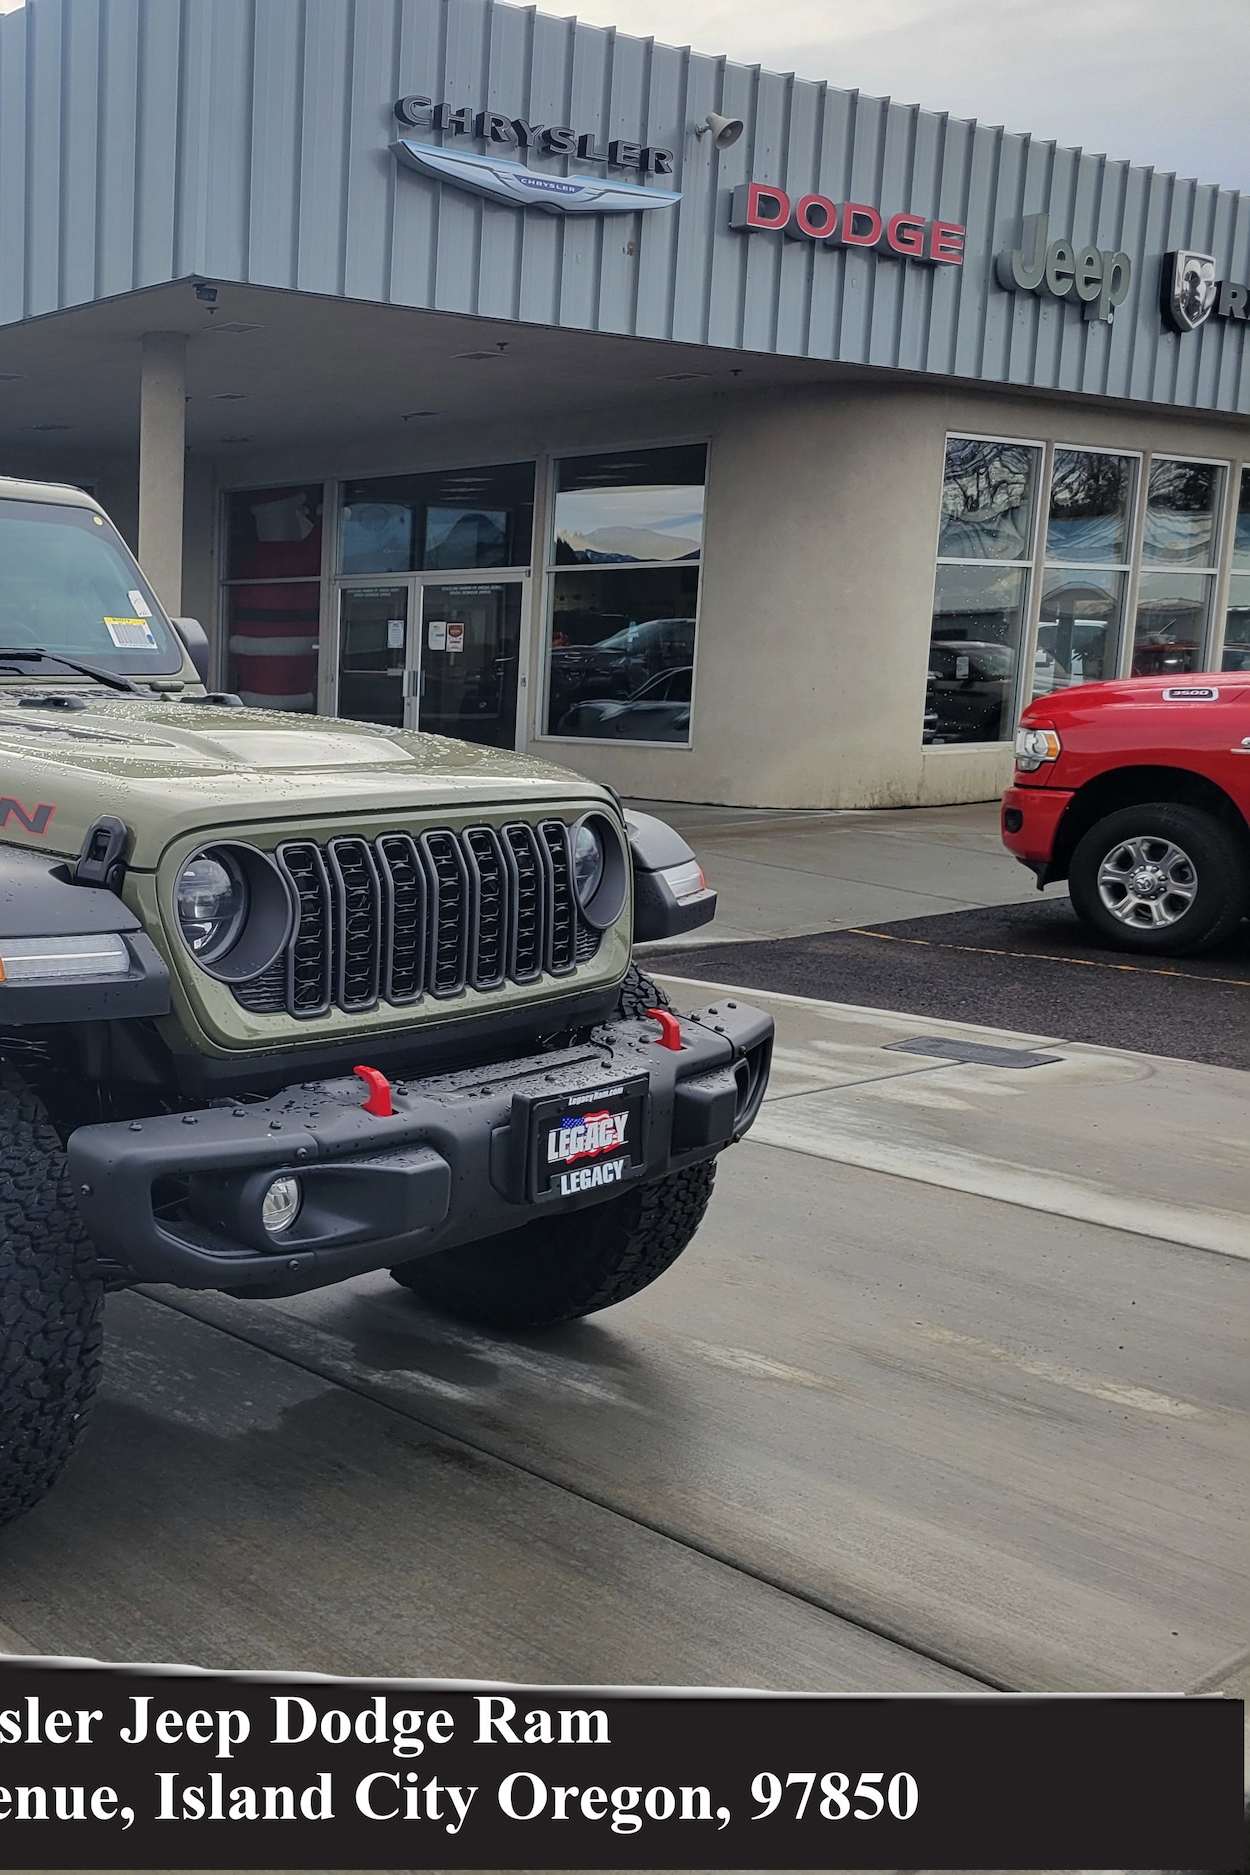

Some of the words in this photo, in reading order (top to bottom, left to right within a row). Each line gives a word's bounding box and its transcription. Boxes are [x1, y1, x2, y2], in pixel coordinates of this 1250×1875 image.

[396, 94, 674, 175] CHRYSLER
[520, 178, 576, 192] CHRYSLER
[746, 182, 966, 265] DODGE
[1002, 213, 1131, 322] Jeep
[547, 1114, 629, 1161] LEGACY
[561, 1161, 624, 1195] LEGACY
